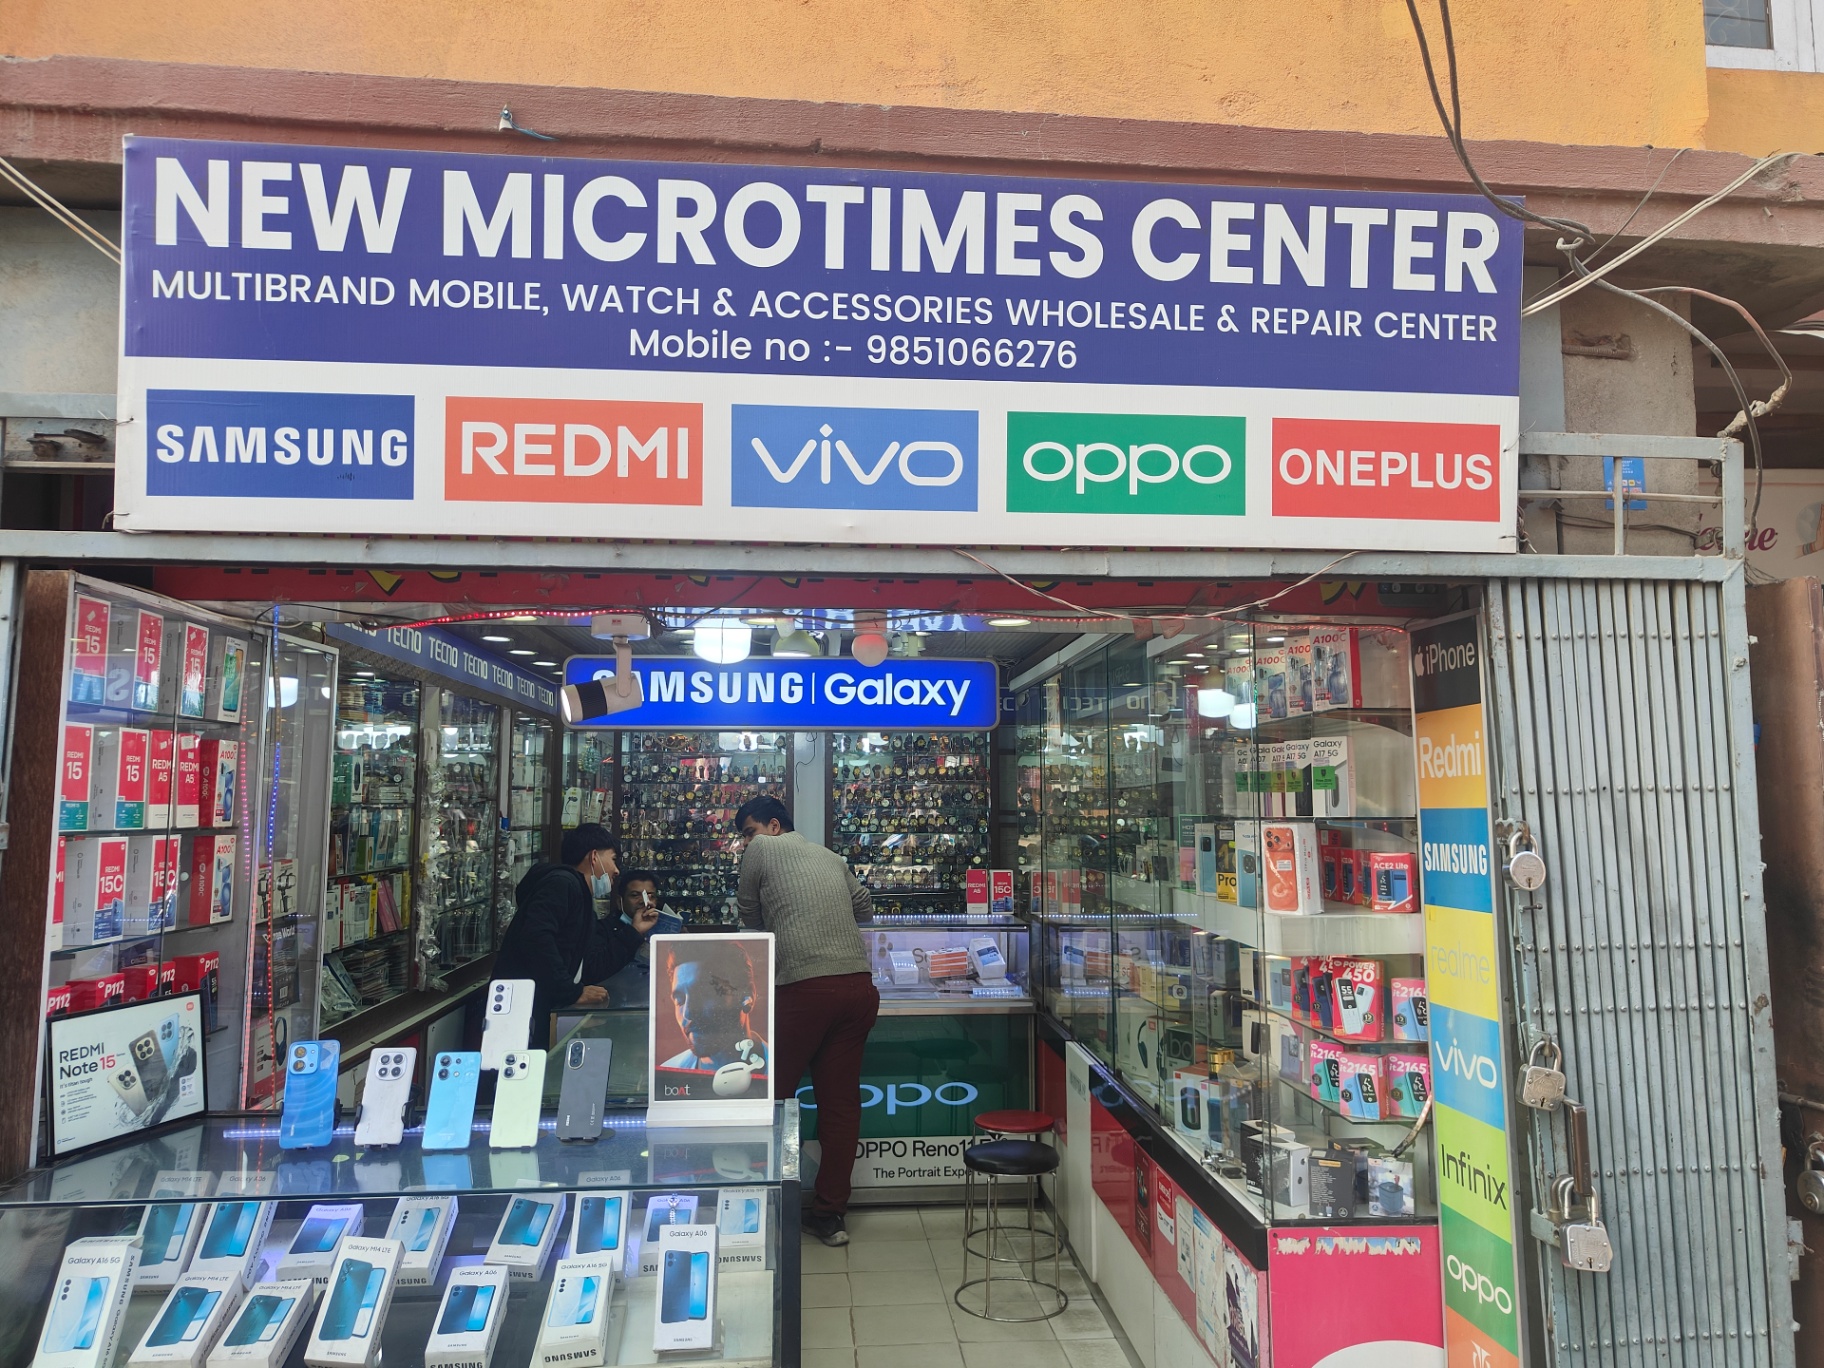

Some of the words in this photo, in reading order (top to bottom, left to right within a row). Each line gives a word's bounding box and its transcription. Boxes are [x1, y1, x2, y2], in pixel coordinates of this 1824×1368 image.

[154, 156, 412, 254] NEW
[443, 169, 1104, 279] MICROTIMES
[1131, 197, 1500, 294] CENTER
[151, 269, 395, 306] MULTIBRAND
[408, 279, 550, 317] MOBILE,
[561, 282, 700, 316] WATCH
[713, 289, 737, 318] &
[749, 290, 993, 326] ACCESSORIES
[1006, 298, 1205, 332] WHOLESALE
[1216, 304, 1241, 334] &
[1251, 307, 1362, 338] REPAIR
[1374, 311, 1499, 343] CENTER
[629, 328, 752, 362] Mobile
[765, 336, 811, 362] no
[866, 334, 1078, 371] 9851066276
[156, 423, 409, 467] SAMSUNG
[461, 420, 690, 480] REDMI
[751, 423, 964, 486] vivo
[1023, 440, 1232, 496] oppo
[1278, 447, 1493, 491] ONEPLUS
[85, 625, 102, 634] REDMI
[1313, 632, 1346, 644] A100C
[84, 635, 100, 654] 15
[1288, 644, 1310, 655] A100
[144, 647, 156, 664] 15
[1426, 640, 1476, 677] iPhone
[428, 636, 458, 669] TECNO
[464, 651, 488, 680] TECNO
[492, 664, 514, 690] TECNO
[517, 675, 536, 699] TECNO
[538, 684, 554, 707] TECNO
[591, 668, 803, 704] MSUNG
[824, 672, 972, 717] Galaxy
[1286, 744, 1310, 752] Galaxy
[1314, 740, 1342, 748] Galaxy
[152, 758, 171, 770] REDM
[1420, 730, 1482, 780] Redmi
[66, 762, 82, 780] 15
[126, 764, 140, 782] 15
[180, 762, 200, 772] REDMI
[158, 772, 168, 782] A5
[185, 774, 194, 784] A5
[1424, 840, 1488, 876] SAMSUNG
[100, 874, 123, 894] 15C
[1218, 874, 1237, 886] Pro
[994, 885, 1011, 894] 15C
[205, 955, 219, 972] P112
[1343, 961, 1375, 970] POWER
[1431, 944, 1491, 986] realme
[1342, 968, 1375, 982] 450
[104, 980, 124, 998] P112
[1341, 986, 1352, 994] 55
[47, 994, 70, 1012] P112
[60, 1042, 104, 1063] REDMI
[1310, 1050, 1341, 1060] it2165
[60, 1061, 98, 1080] Note
[100, 1054, 116, 1070] 15
[1340, 1062, 1376, 1075] it2165
[1390, 1061, 1427, 1074] it2165
[1435, 1037, 1497, 1089] vivo
[873, 1167, 895, 1179] The
[897, 1166, 942, 1179] Portrait
[1440, 1143, 1508, 1211] Infinix
[68, 1257, 96, 1265] Galaxy
[119, 1254, 135, 1305] SAMSUNG
[508, 1270, 533, 1278] SAMS
[1446, 1254, 1512, 1316] oppo
[544, 1349, 597, 1363] SAMSUNG
